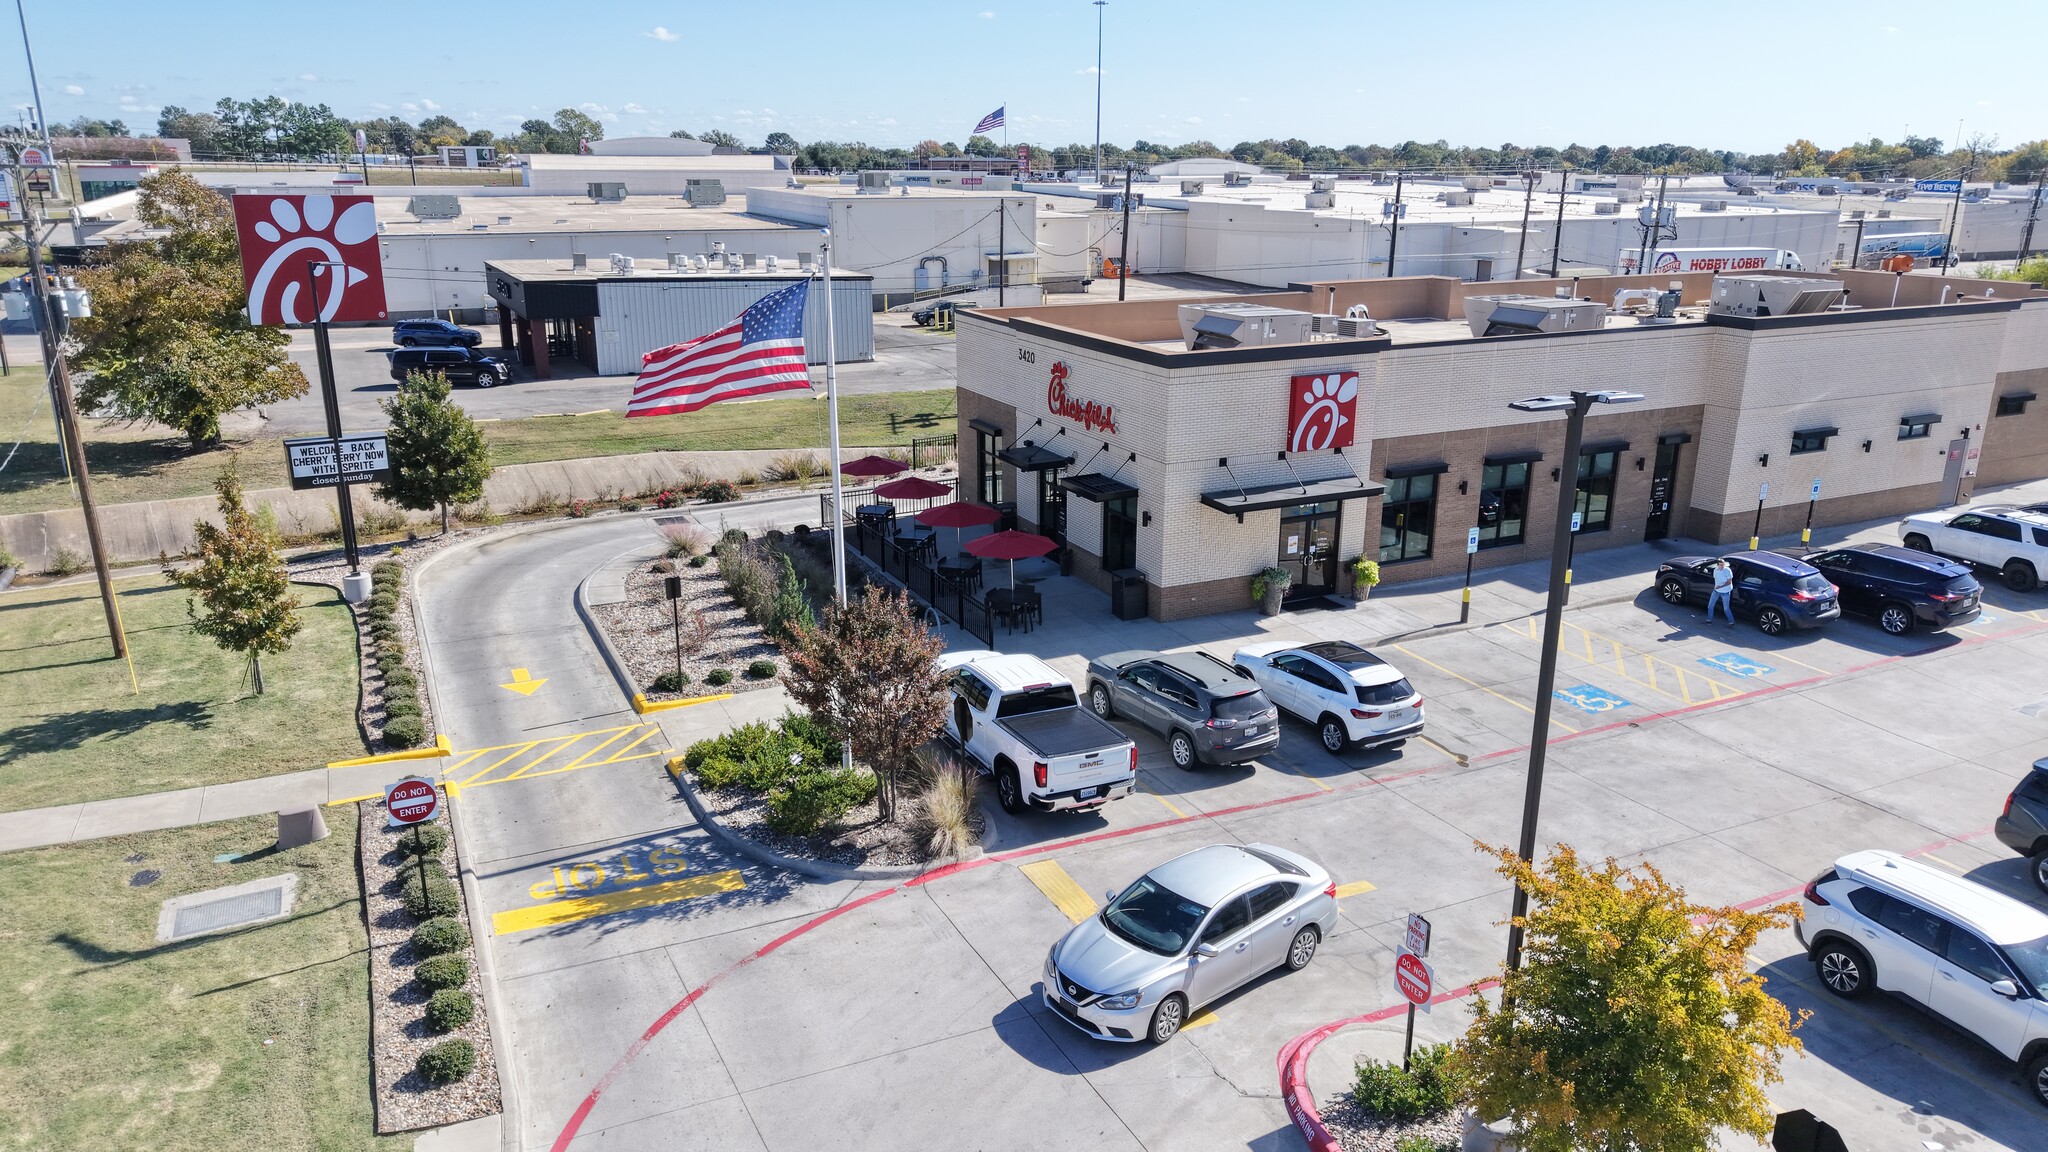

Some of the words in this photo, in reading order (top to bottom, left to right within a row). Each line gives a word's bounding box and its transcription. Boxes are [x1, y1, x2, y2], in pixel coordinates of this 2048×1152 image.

[1690, 259, 1729, 271] HOBBY
[1731, 258, 1768, 269] LOBBY
[1018, 348, 1035, 364] 3420
[351, 442, 375, 452] BACK
[293, 456, 328, 467] CHERRY
[333, 453, 361, 463] BERRY
[365, 451, 384, 460] NOW
[312, 465, 336, 474] WITH
[342, 461, 374, 471] SPRITE
[312, 476, 340, 485] closed
[1080, 760, 1104, 769] GMC
[394, 791, 407, 799] DO
[410, 787, 427, 796] NOT
[400, 805, 428, 817] ENTER
[528, 848, 688, 900] STOP
[1414, 919, 1421, 929] NO
[1408, 925, 1425, 940] PARKING
[1411, 935, 1420, 946] FIRE
[1402, 958, 1411, 969] DO
[1413, 965, 1427, 980] NOT
[1401, 978, 1424, 1000] ENTER
[1288, 1093, 1297, 1106] NO
[1294, 1106, 1315, 1142] PARKING
